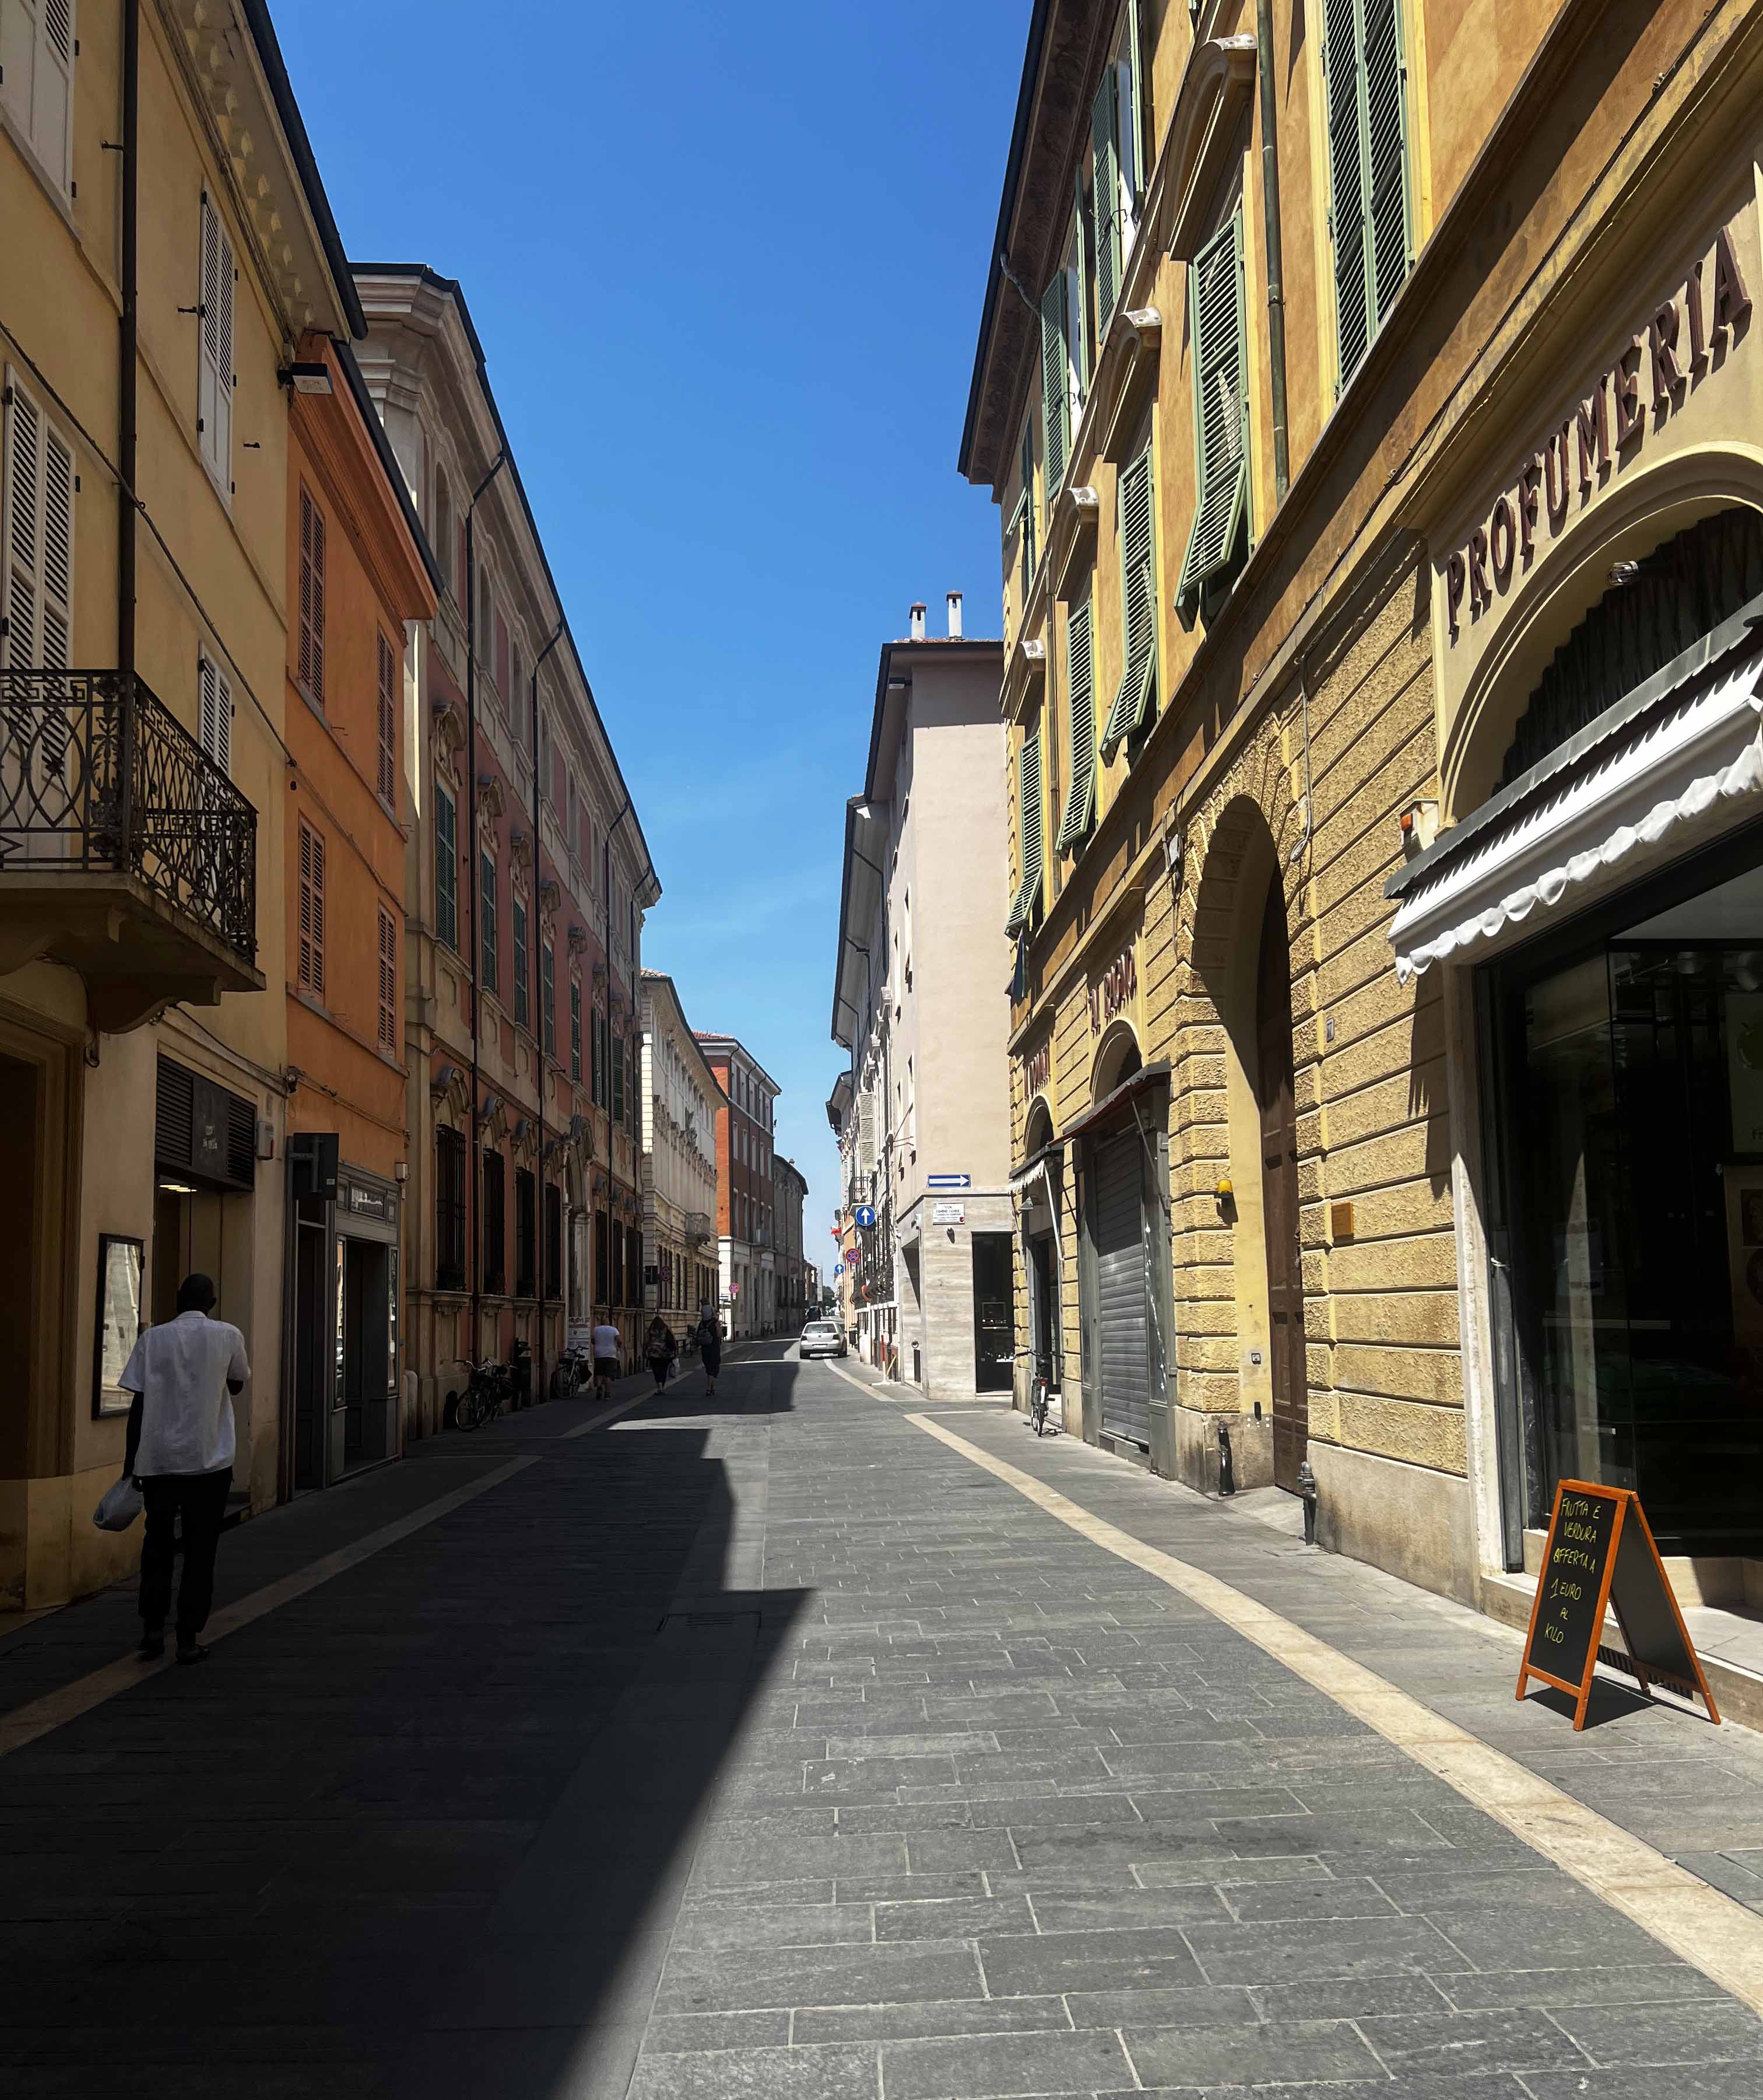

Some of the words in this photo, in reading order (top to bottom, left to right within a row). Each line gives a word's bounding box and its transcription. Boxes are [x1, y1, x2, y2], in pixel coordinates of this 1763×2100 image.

[1446, 225, 1752, 635] PROFUMERIA
[1561, 1498, 1588, 1517] FRUTTA
[1592, 1505, 1601, 1519] E
[1564, 1522, 1597, 1543] VERDURA
[1553, 1548, 1588, 1569] OFFERTA
[1589, 1558, 1596, 1574] A
[1550, 1578, 1558, 1599] 1
[1560, 1582, 1582, 1600] EURO
[1560, 1607, 1568, 1620] AL
[1544, 1623, 1564, 1644] KILO
